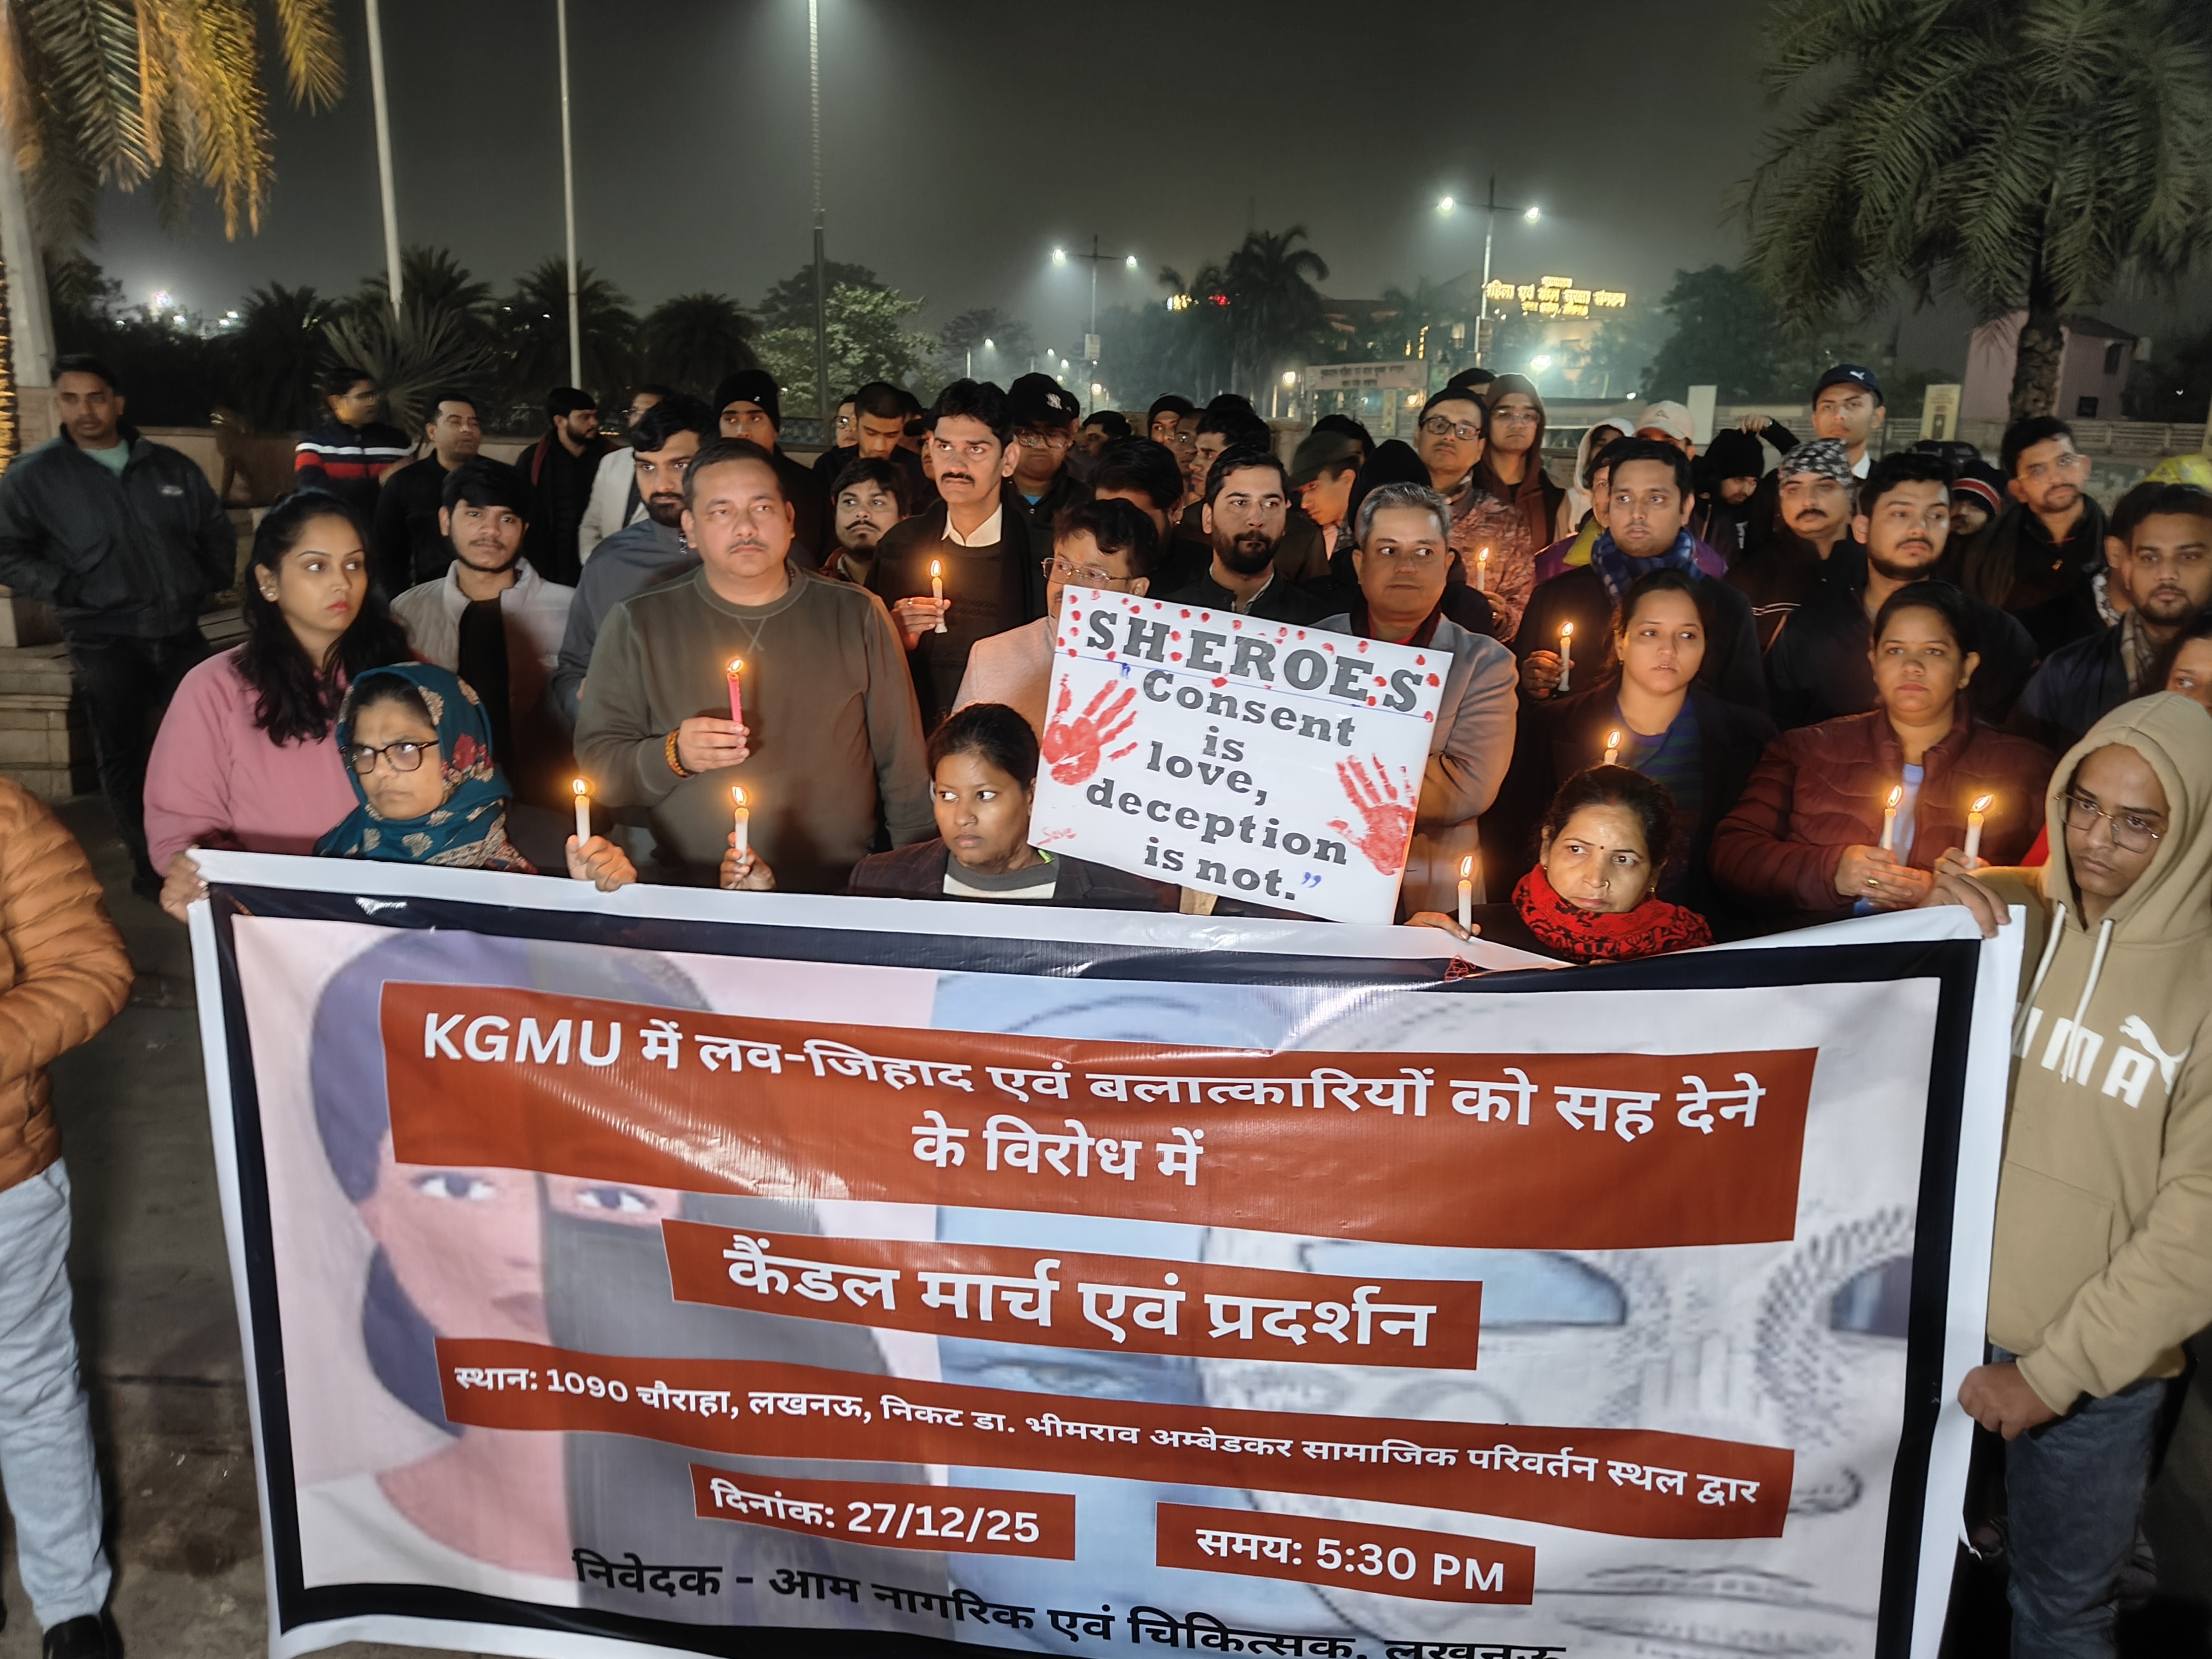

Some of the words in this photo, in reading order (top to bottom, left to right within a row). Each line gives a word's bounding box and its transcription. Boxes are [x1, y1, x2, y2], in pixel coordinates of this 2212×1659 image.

[1087, 610, 1423, 712] SHEROES
[1147, 740, 1267, 806] love,
[1202, 725, 1244, 762] is
[1086, 778, 1347, 865] deception
[1143, 837, 1184, 871] is
[425, 1013, 621, 1067] KGMU
[640, 1019, 683, 1069] में
[694, 1035, 974, 1092] लव-जिहाद
[985, 1062, 1071, 1102] एवं
[1085, 1068, 1434, 1116] बलात्कारियों
[1450, 1068, 1538, 1125] को
[1554, 1087, 1660, 1142] सह
[1676, 1073, 1766, 1134] देने
[912, 1110, 969, 1167] के
[982, 1115, 1142, 1181] विरोध
[1156, 1127, 1204, 1186] में
[723, 1235, 900, 1310] कैंडल
[918, 1258, 1061, 1326] मार्च
[1077, 1272, 1186, 1343] एवं
[1204, 1286, 1437, 1346] प्रदर्शन
[455, 1368, 537, 1390] स्थान:
[547, 1369, 628, 1401] 1090
[636, 1380, 738, 1419] चौराहा,
[748, 1392, 871, 1424] लखनऊ,
[880, 1395, 963, 1426] निकट
[971, 1412, 1015, 1432] डा.
[1026, 1413, 1140, 1444] भीमराव
[1150, 1427, 1293, 1457] अम्बेडकर
[1301, 1439, 1458, 1466] सामाजिक
[1467, 1445, 1599, 1481] परिवर्तन
[1607, 1460, 1688, 1495] स्थल
[1697, 1474, 1760, 1506] द्वार
[848, 1502, 1039, 1542] 27/12/25
[1196, 1529, 1301, 1564] समय:
[1317, 1539, 1416, 1580] 5:30
[1434, 1553, 1503, 1591] PM
[572, 1547, 723, 1597] निवेदक
[769, 1569, 861, 1603] आम
[871, 1583, 1035, 1629] नागरिक
[1047, 1605, 1115, 1642] एवं
